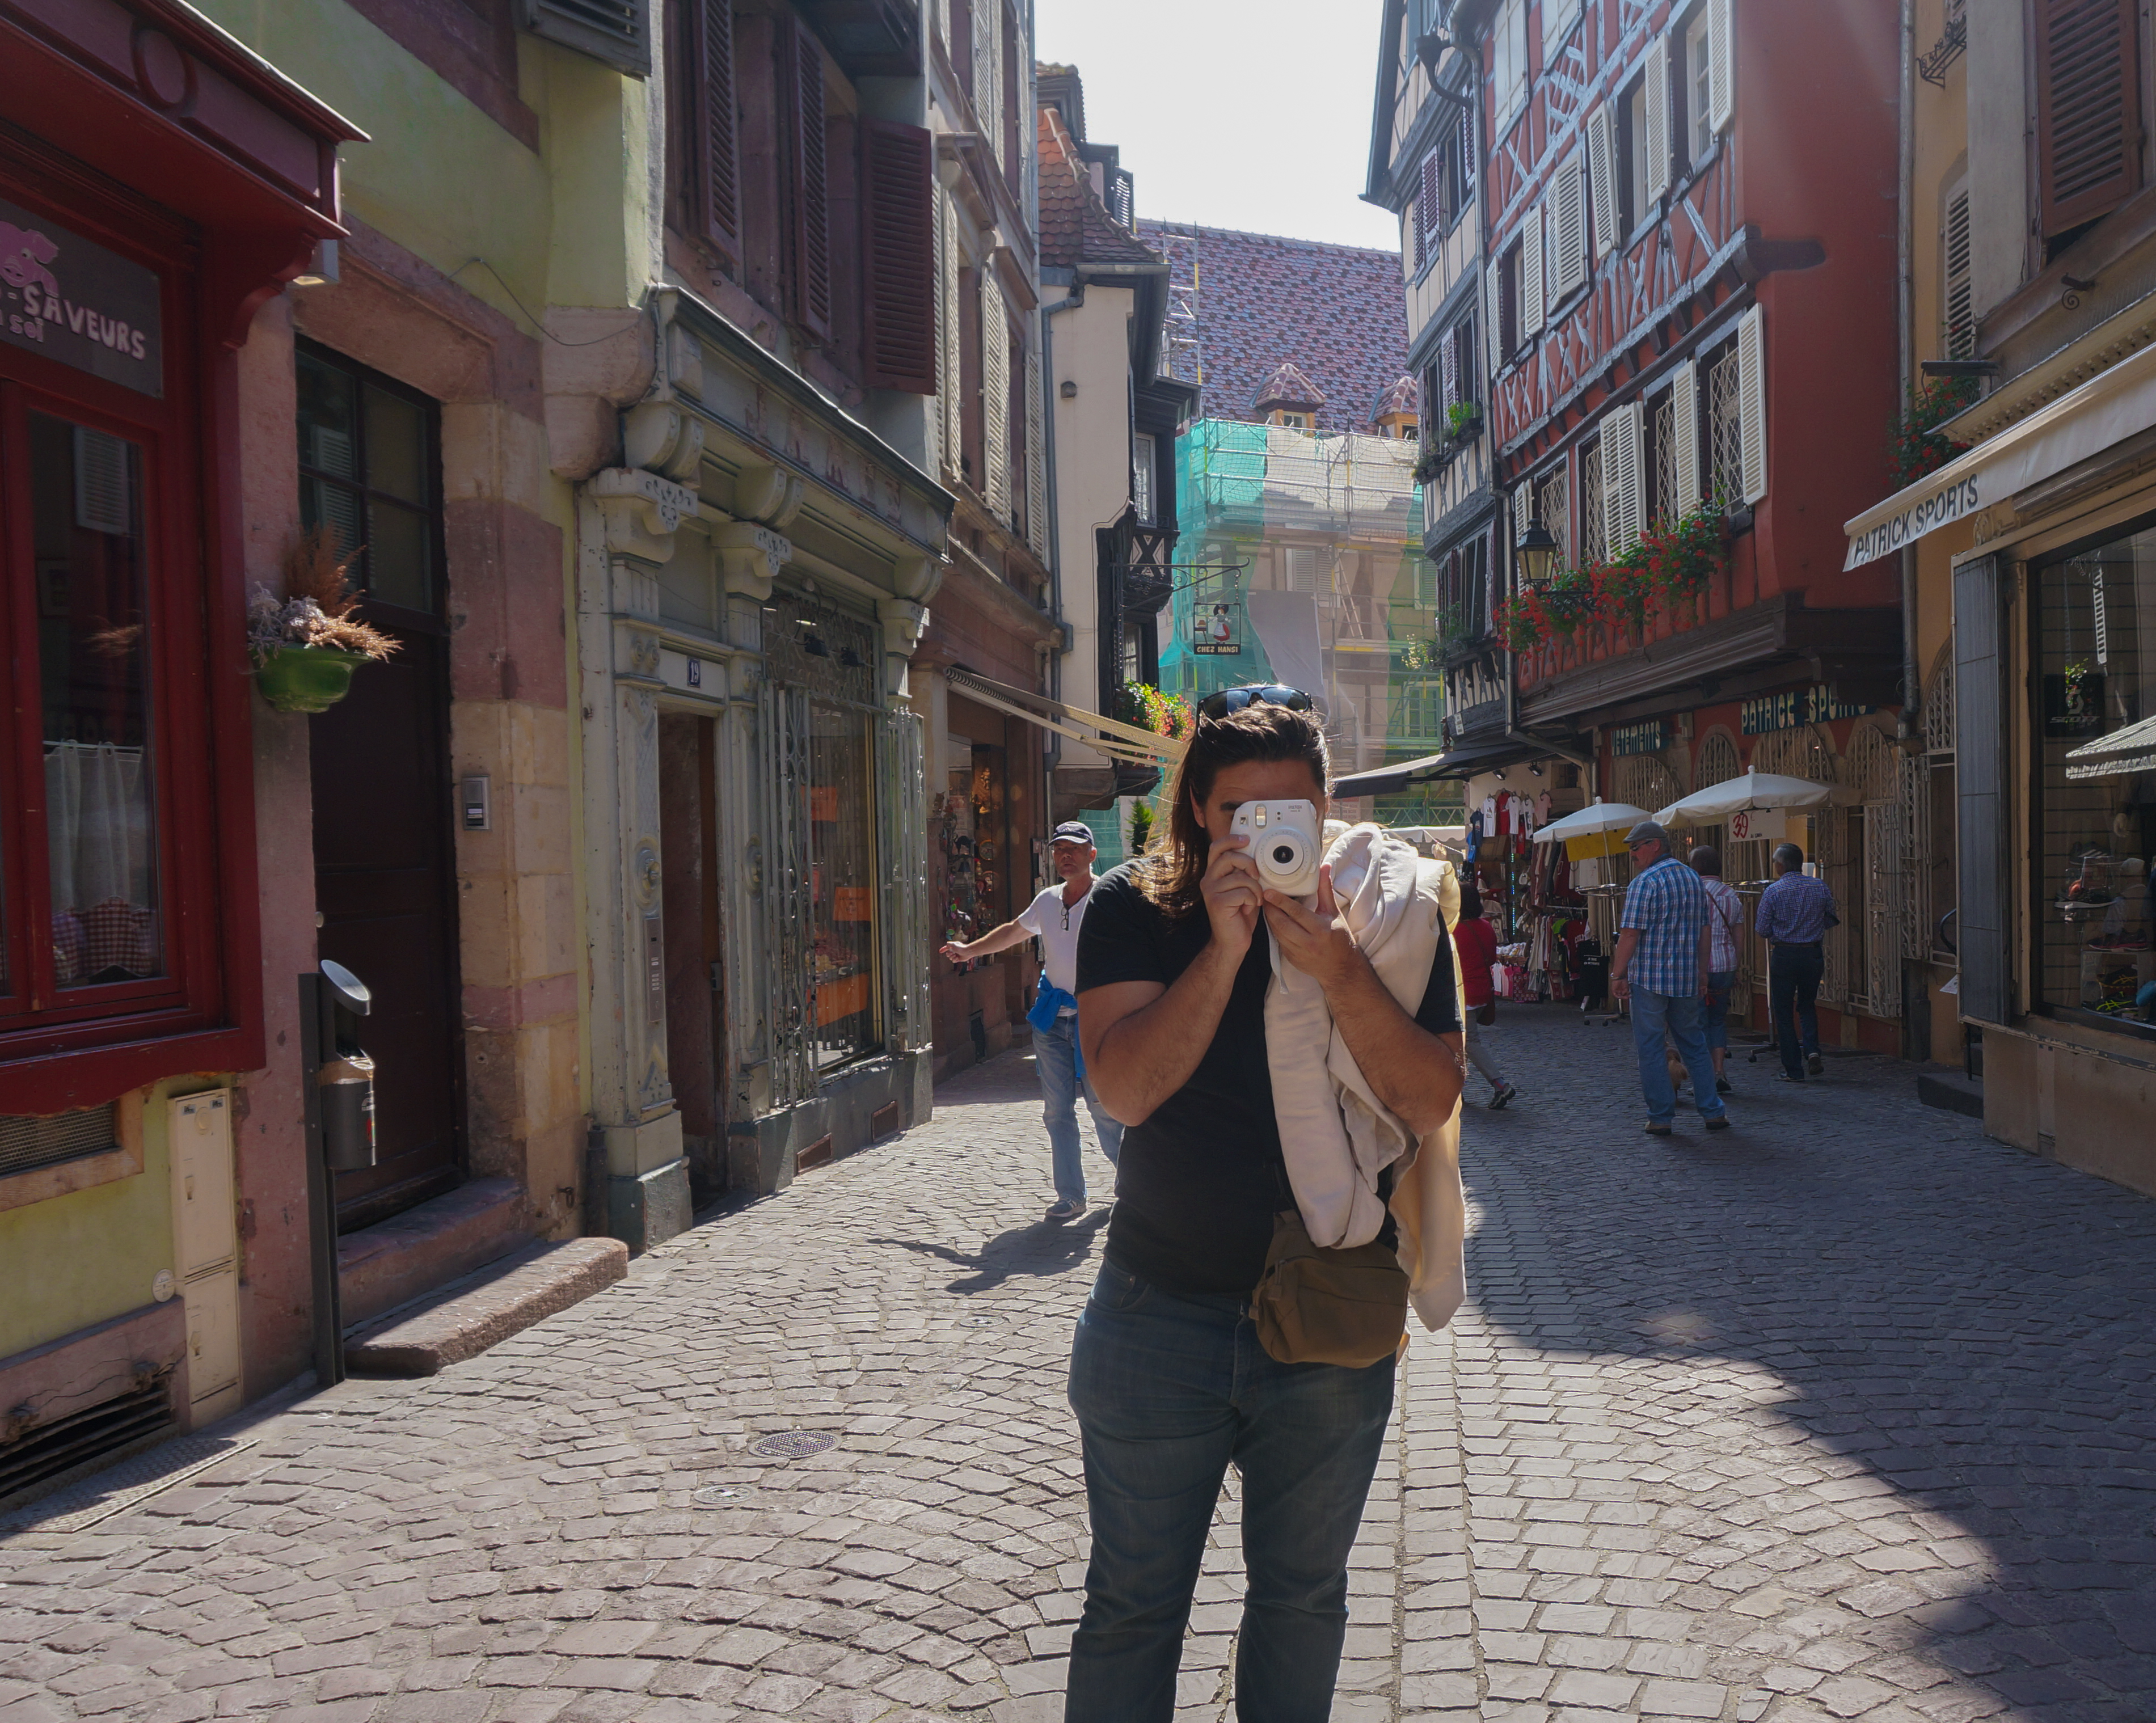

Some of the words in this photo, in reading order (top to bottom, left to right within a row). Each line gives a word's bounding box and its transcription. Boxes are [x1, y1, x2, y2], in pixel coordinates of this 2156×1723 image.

[23, 284, 146, 360] SAVEURS
[1853, 509, 1912, 564] PATRICK
[1915, 473, 1978, 534] SPORTS
[690, 661, 699, 683] 19
[1741, 692, 1795, 735] PATRICK
[1733, 814, 1748, 839] 39
